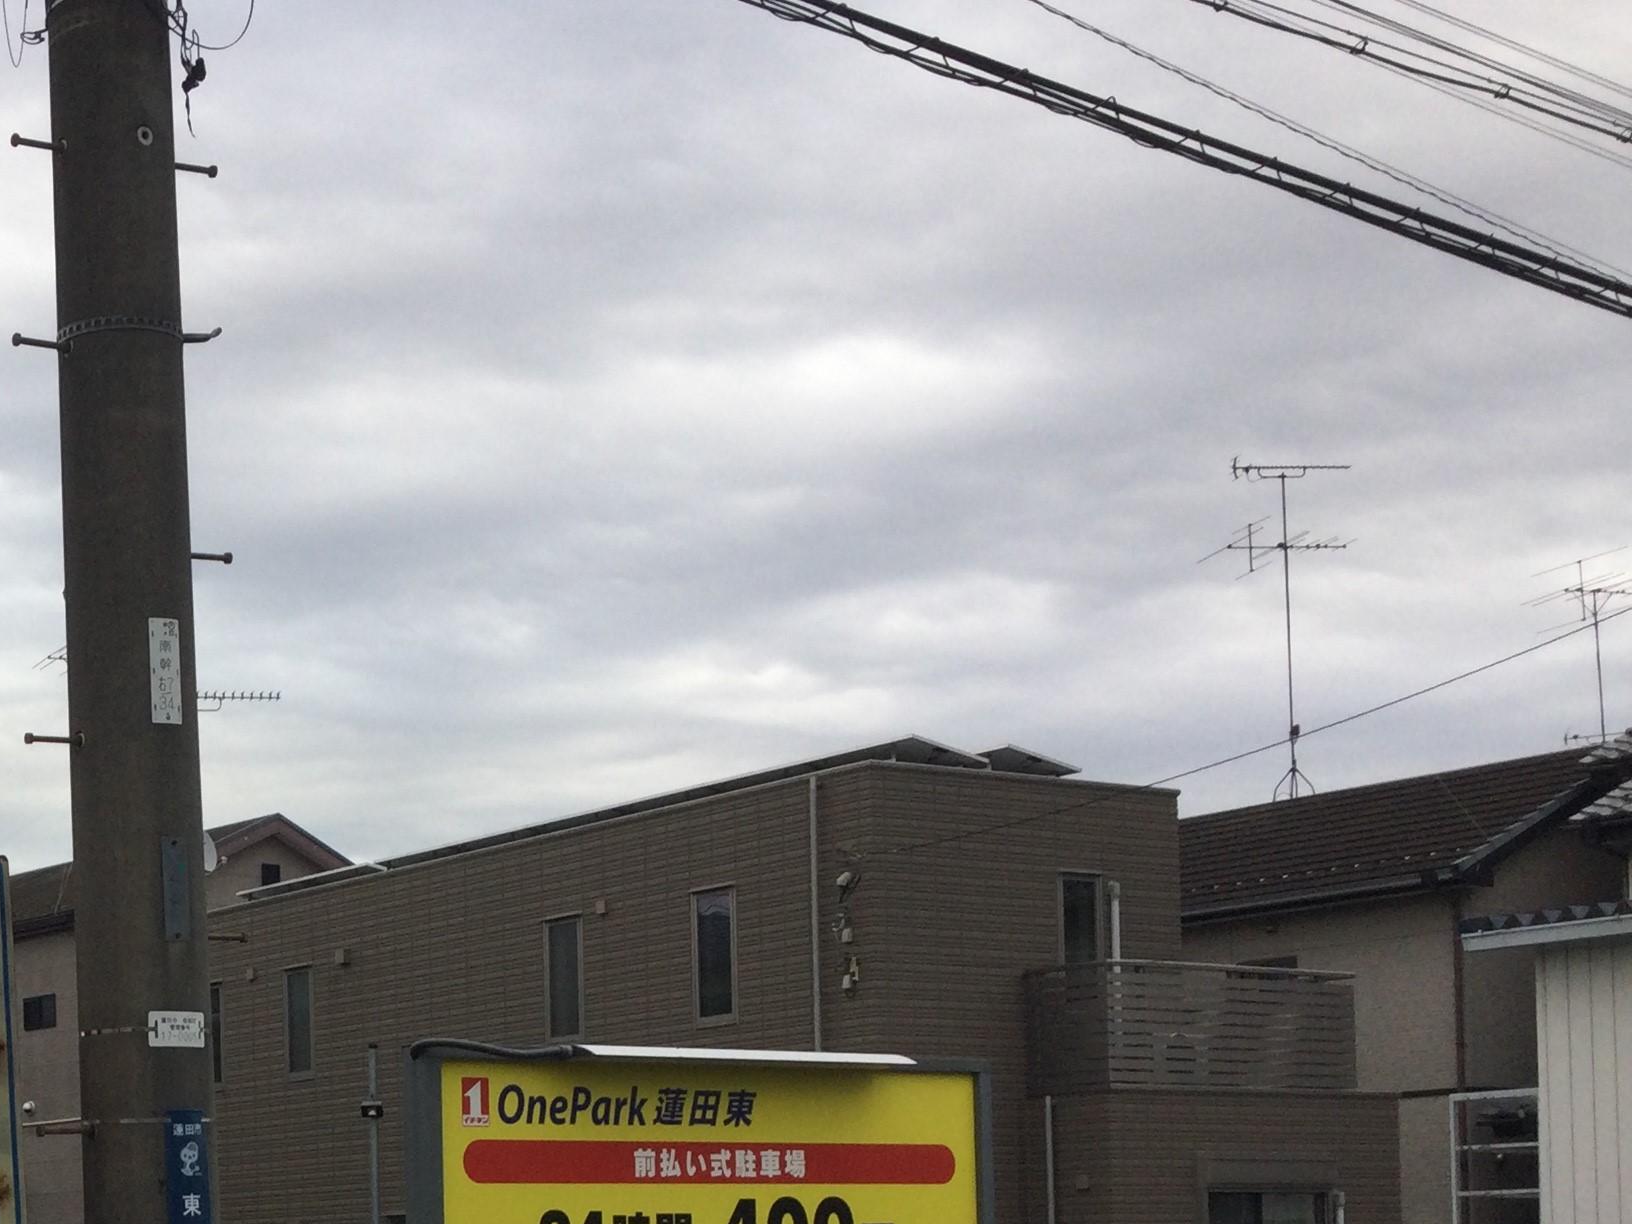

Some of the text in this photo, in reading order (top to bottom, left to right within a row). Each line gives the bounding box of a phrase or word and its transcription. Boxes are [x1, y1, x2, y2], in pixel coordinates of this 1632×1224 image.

[498, 1084, 647, 1127] OnePark
[652, 1087, 757, 1127] 蓮田東
[634, 1148, 806, 1178] 前払い式駐車場
